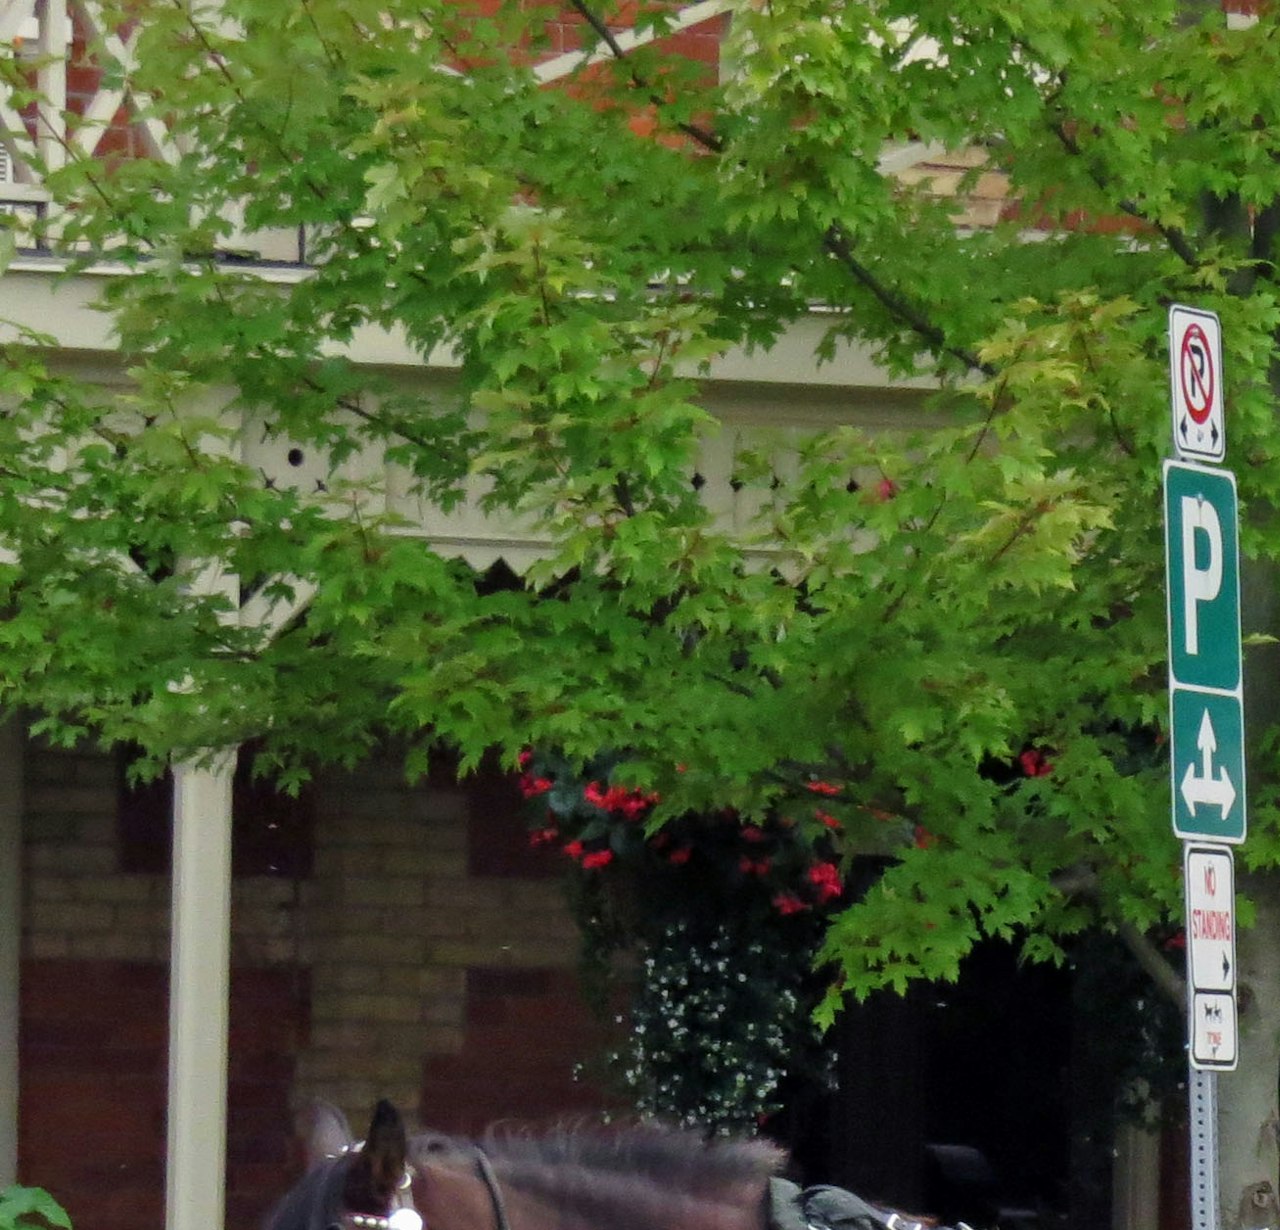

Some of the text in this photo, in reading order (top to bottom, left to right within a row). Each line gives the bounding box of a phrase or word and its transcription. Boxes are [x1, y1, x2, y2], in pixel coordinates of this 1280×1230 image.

[1181, 495, 1223, 655] P
[1203, 865, 1217, 896] NO
[1193, 908, 1232, 941] STANDING
